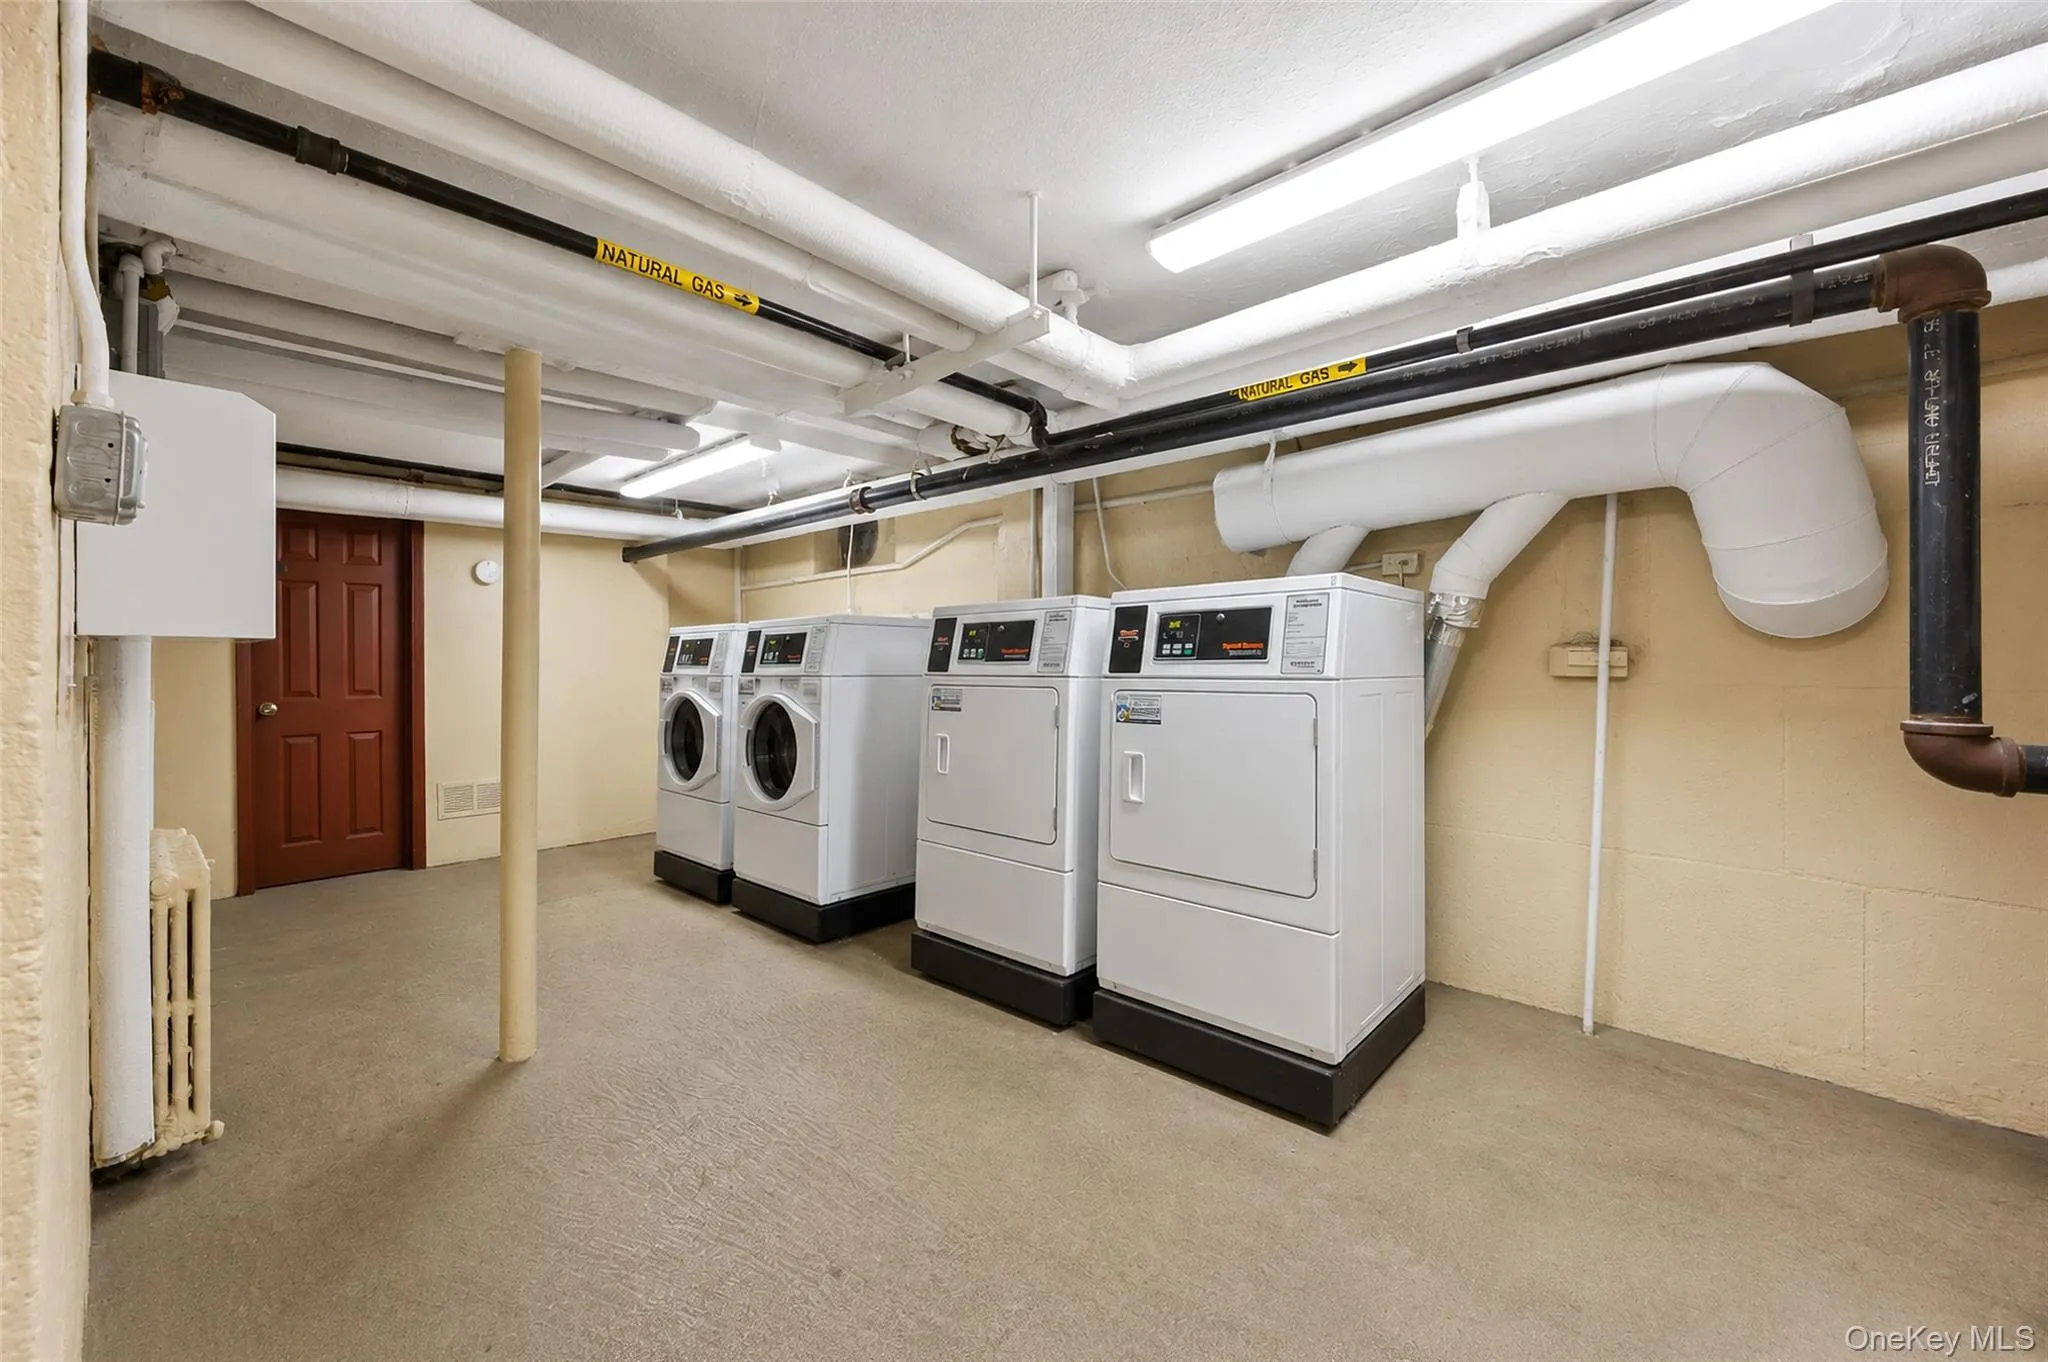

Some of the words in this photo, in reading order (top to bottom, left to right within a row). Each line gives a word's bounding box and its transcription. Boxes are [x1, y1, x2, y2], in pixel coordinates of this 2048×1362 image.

[602, 243, 683, 286] NATURAL
[692, 275, 725, 300] GAS
[1241, 377, 1293, 398] NATURAL
[1300, 367, 1330, 385] GAS
